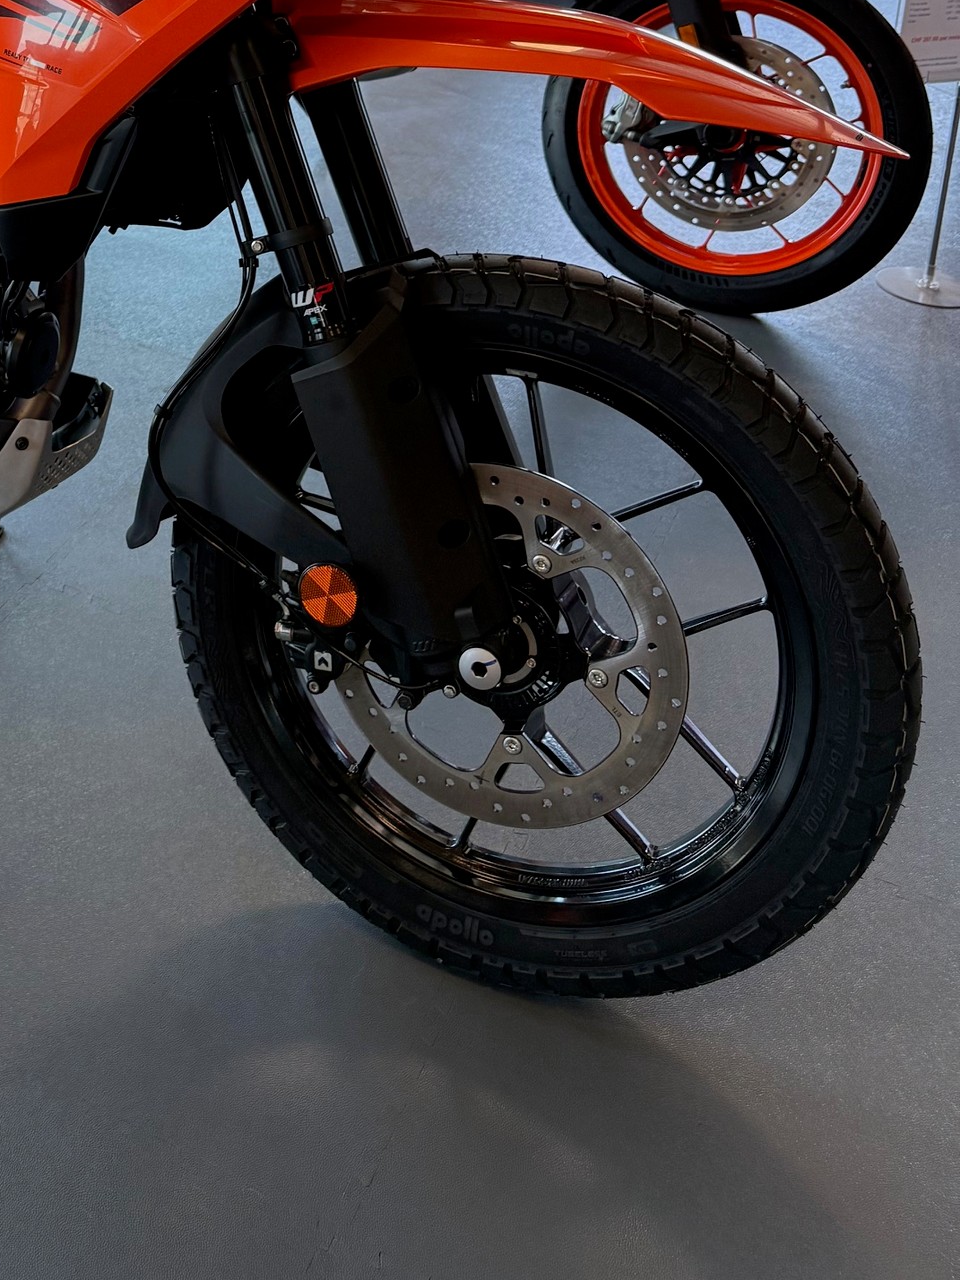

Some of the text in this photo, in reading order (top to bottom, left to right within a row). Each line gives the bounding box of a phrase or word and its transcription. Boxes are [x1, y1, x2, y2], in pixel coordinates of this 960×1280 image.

[45, 64, 63, 75] RACE
[291, 281, 335, 308] WP
[303, 304, 328, 317] APEX
[415, 903, 495, 947] apollo
